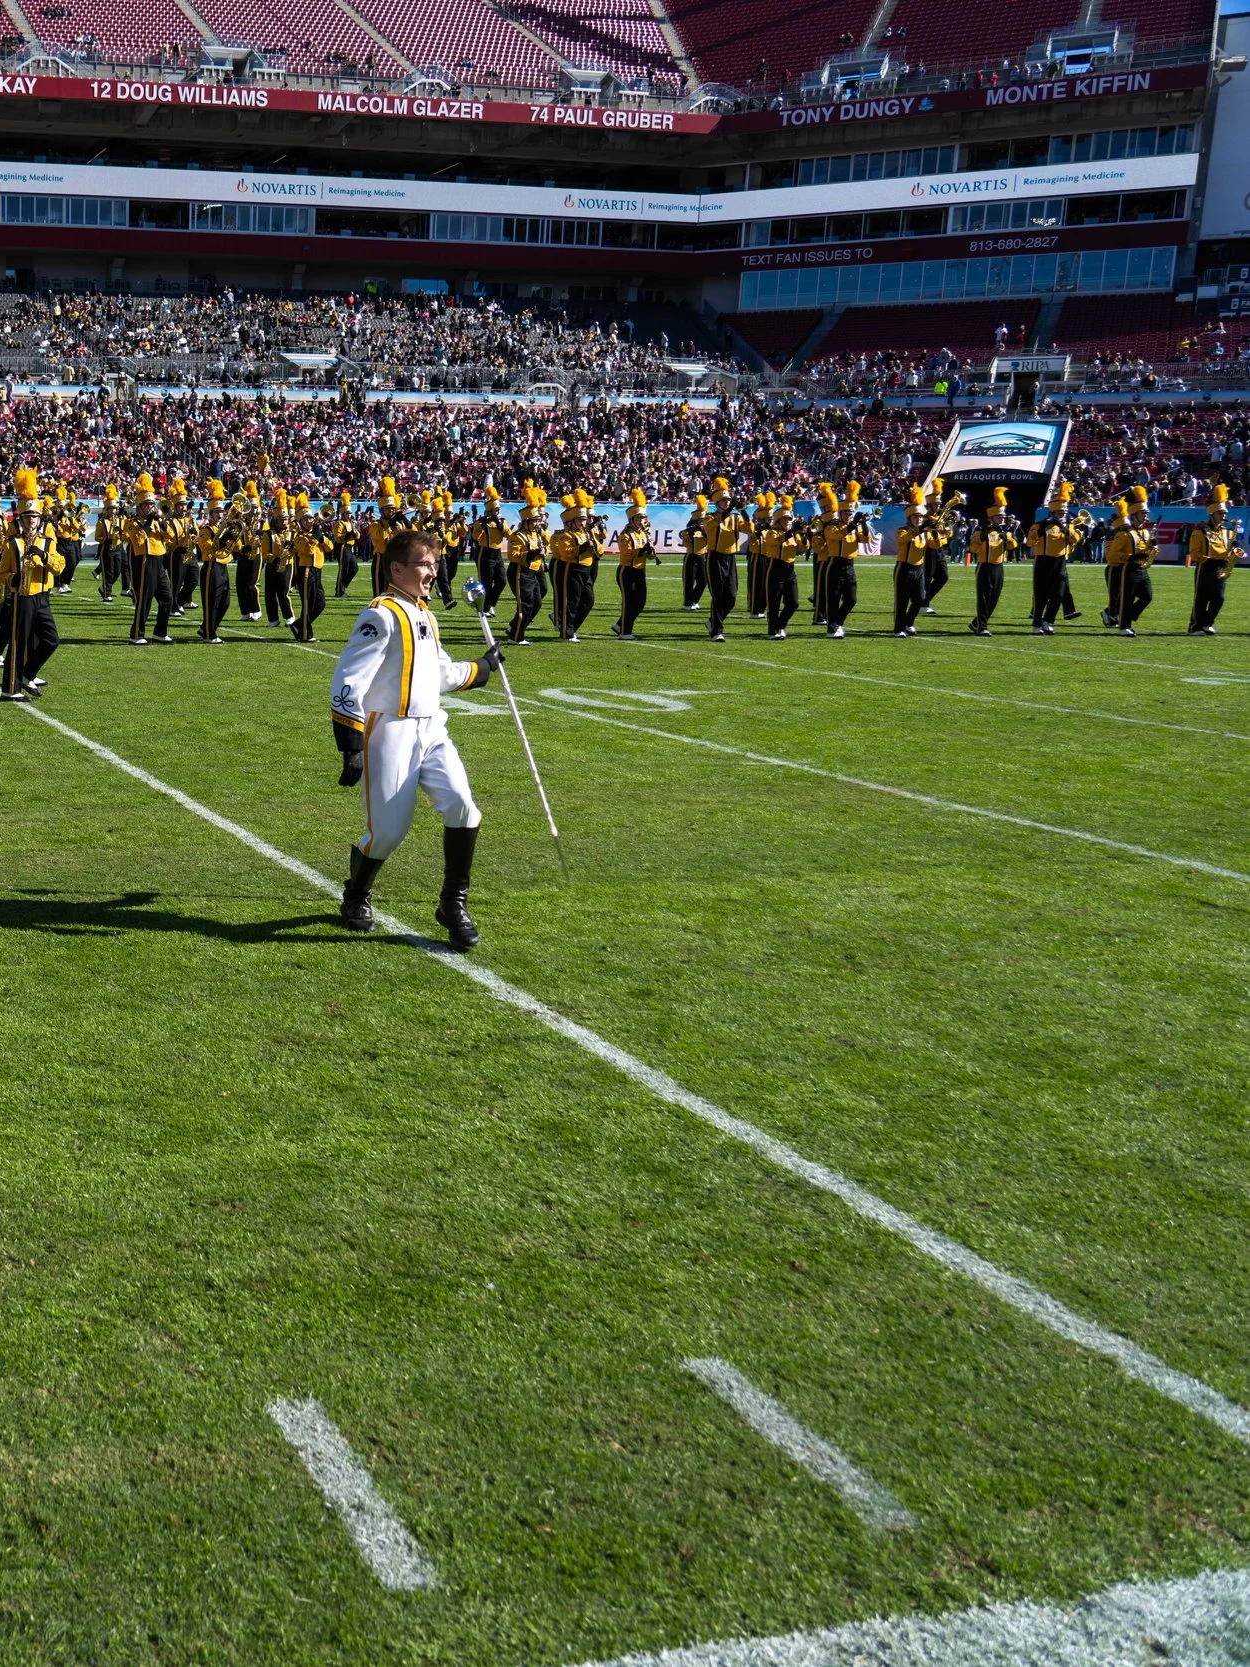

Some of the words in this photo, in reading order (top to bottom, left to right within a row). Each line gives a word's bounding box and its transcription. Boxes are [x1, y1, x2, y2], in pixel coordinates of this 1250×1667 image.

[91, 82, 110, 98] 12
[117, 82, 172, 101] DOUG
[176, 85, 268, 107] WILLIAMS
[986, 81, 1067, 105] MONTE
[1073, 73, 1150, 96] KIFFIN
[318, 94, 408, 114] MALCOLM
[412, 99, 484, 119] GLAZER
[530, 105, 548, 122] 74
[553, 106, 598, 125] PAUL
[602, 108, 674, 129] GRUBER
[779, 105, 834, 126] TONY
[840, 97, 914, 120] DUNGY
[29, 174, 63, 182] Medicine
[252, 183, 316, 195] NOVARTIS
[329, 187, 371, 197] Reimagining
[928, 178, 1008, 195] NOVARTIS
[1024, 176, 1079, 185] Reimagining
[1083, 172, 1124, 180] Medicine
[578, 199, 636, 210] NOVARTIS
[648, 203, 687, 212] Reimagining
[689, 203, 723, 211] Medicine
[742, 255, 772, 265] TEXT
[777, 253, 800, 263] FAN
[805, 250, 851, 261] ISSUES
[855, 248, 873, 258] TO
[970, 236, 1058, 252] 813-680-2827
